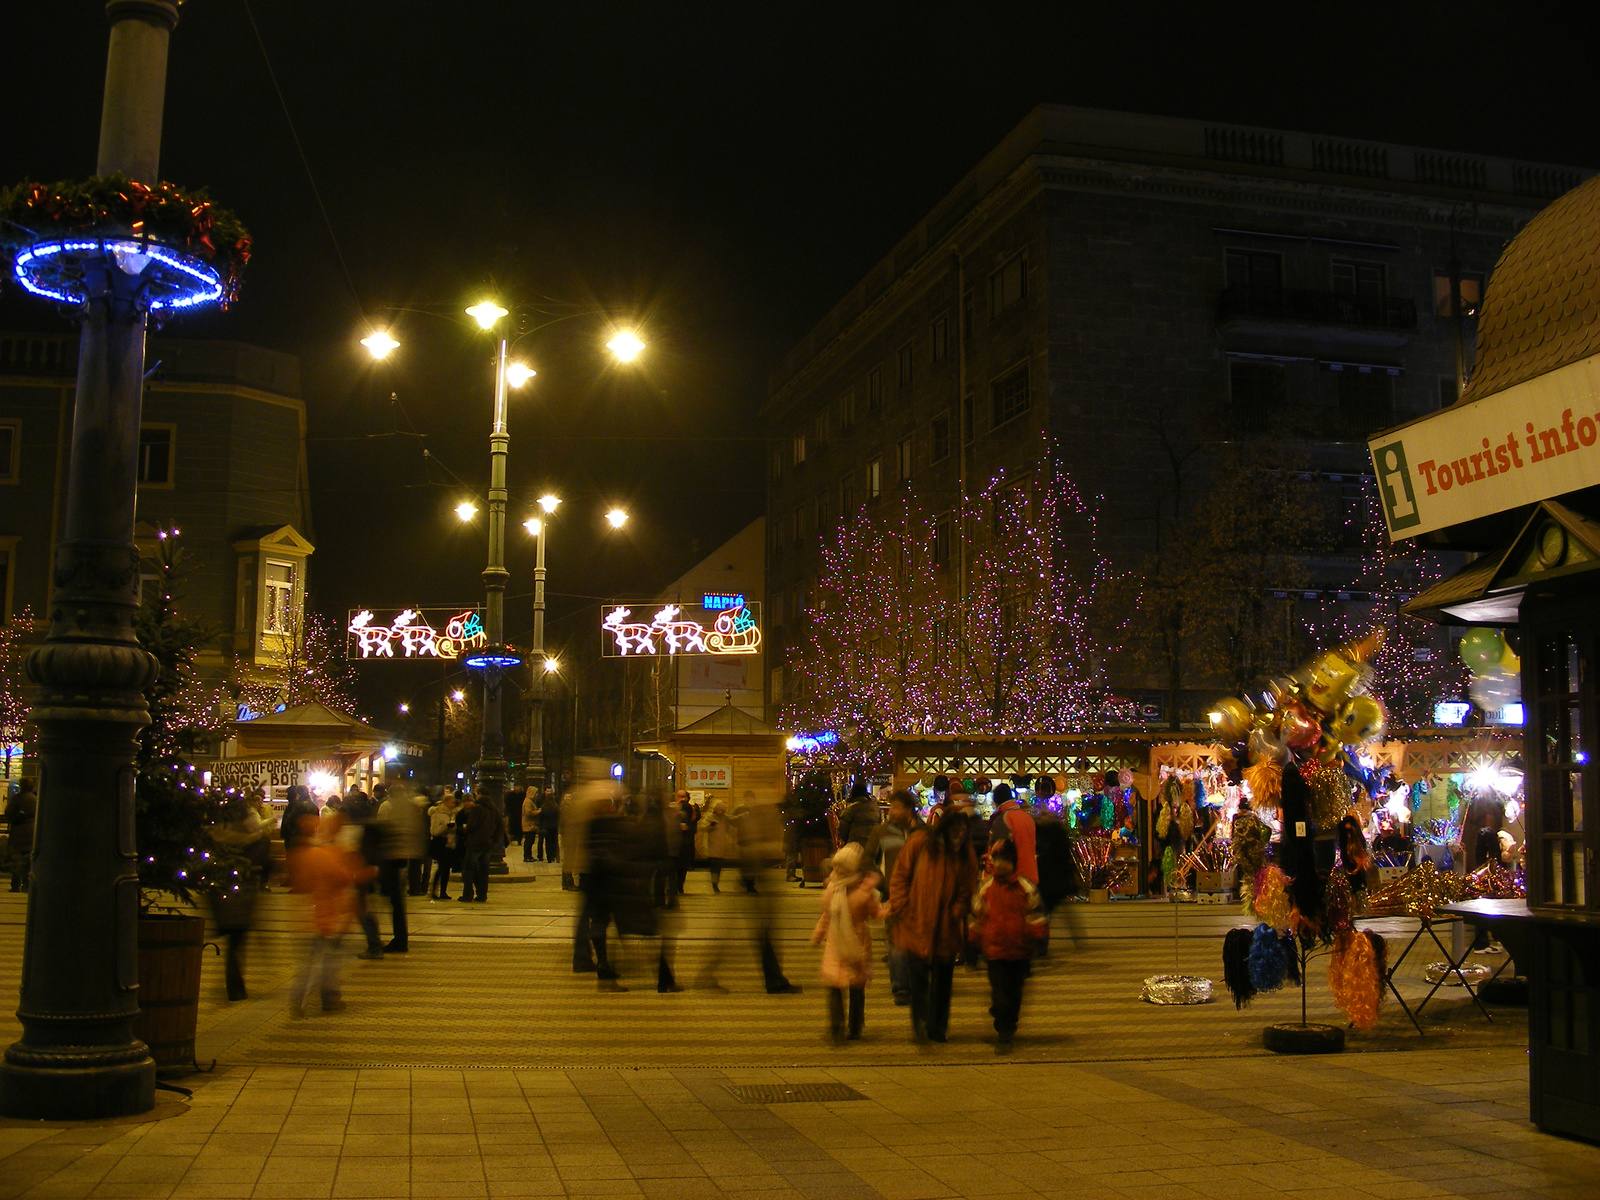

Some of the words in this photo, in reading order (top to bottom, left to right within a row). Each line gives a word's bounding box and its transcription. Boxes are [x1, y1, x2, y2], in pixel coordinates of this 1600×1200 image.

[1417, 431, 1524, 496] Tourist
[1525, 408, 1600, 464] info
[260, 760, 310, 774] FORRALT
[271, 772, 300, 786] BOR
